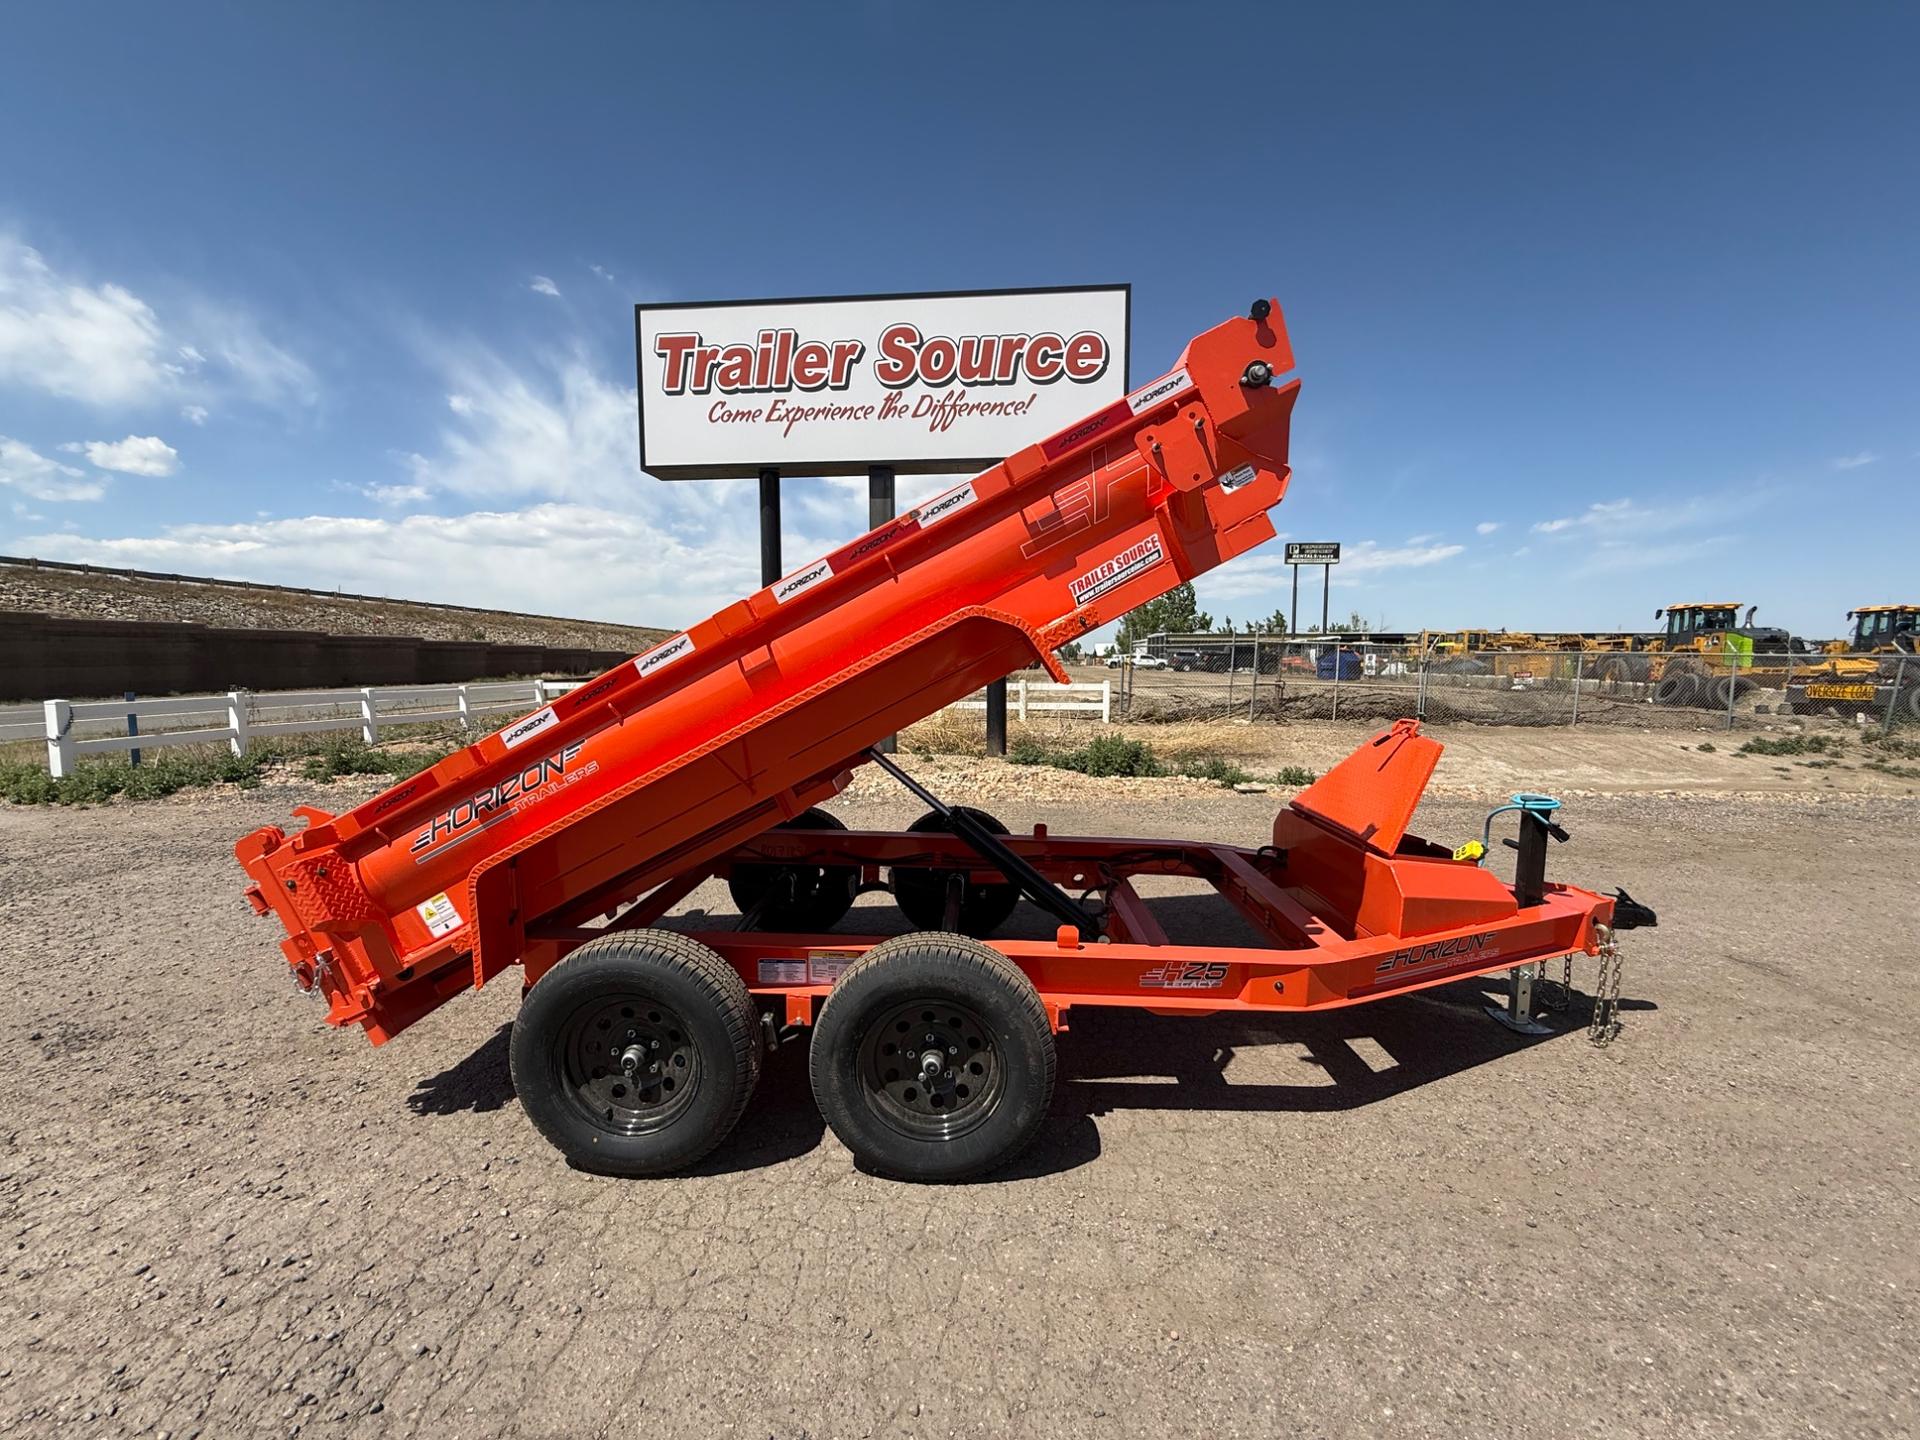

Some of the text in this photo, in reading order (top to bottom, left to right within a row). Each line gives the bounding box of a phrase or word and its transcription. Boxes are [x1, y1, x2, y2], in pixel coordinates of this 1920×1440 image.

[655, 322, 1110, 395] Trailer Source
[1136, 376, 1182, 408] HORIZON
[708, 389, 1037, 438] Come Experience the Difference!
[1061, 417, 1106, 447] HORIZON
[923, 489, 969, 520] HORIZON
[852, 530, 895, 558] HORIZON
[1070, 535, 1159, 596] TRAILER SOURCE
[1078, 552, 1159, 602] www.trailersourceinc.com
[781, 567, 824, 596] HORIZON
[642, 641, 686, 669] HORIZON
[577, 680, 615, 705] HORIZON
[1806, 685, 1847, 698] OVERSIZE
[508, 714, 548, 741] HORIZON
[421, 744, 575, 846] HORIZON
[515, 760, 599, 812] TRAILERS
[1384, 933, 1490, 969] HORIZON
[1163, 980, 1215, 989] LEGACY
